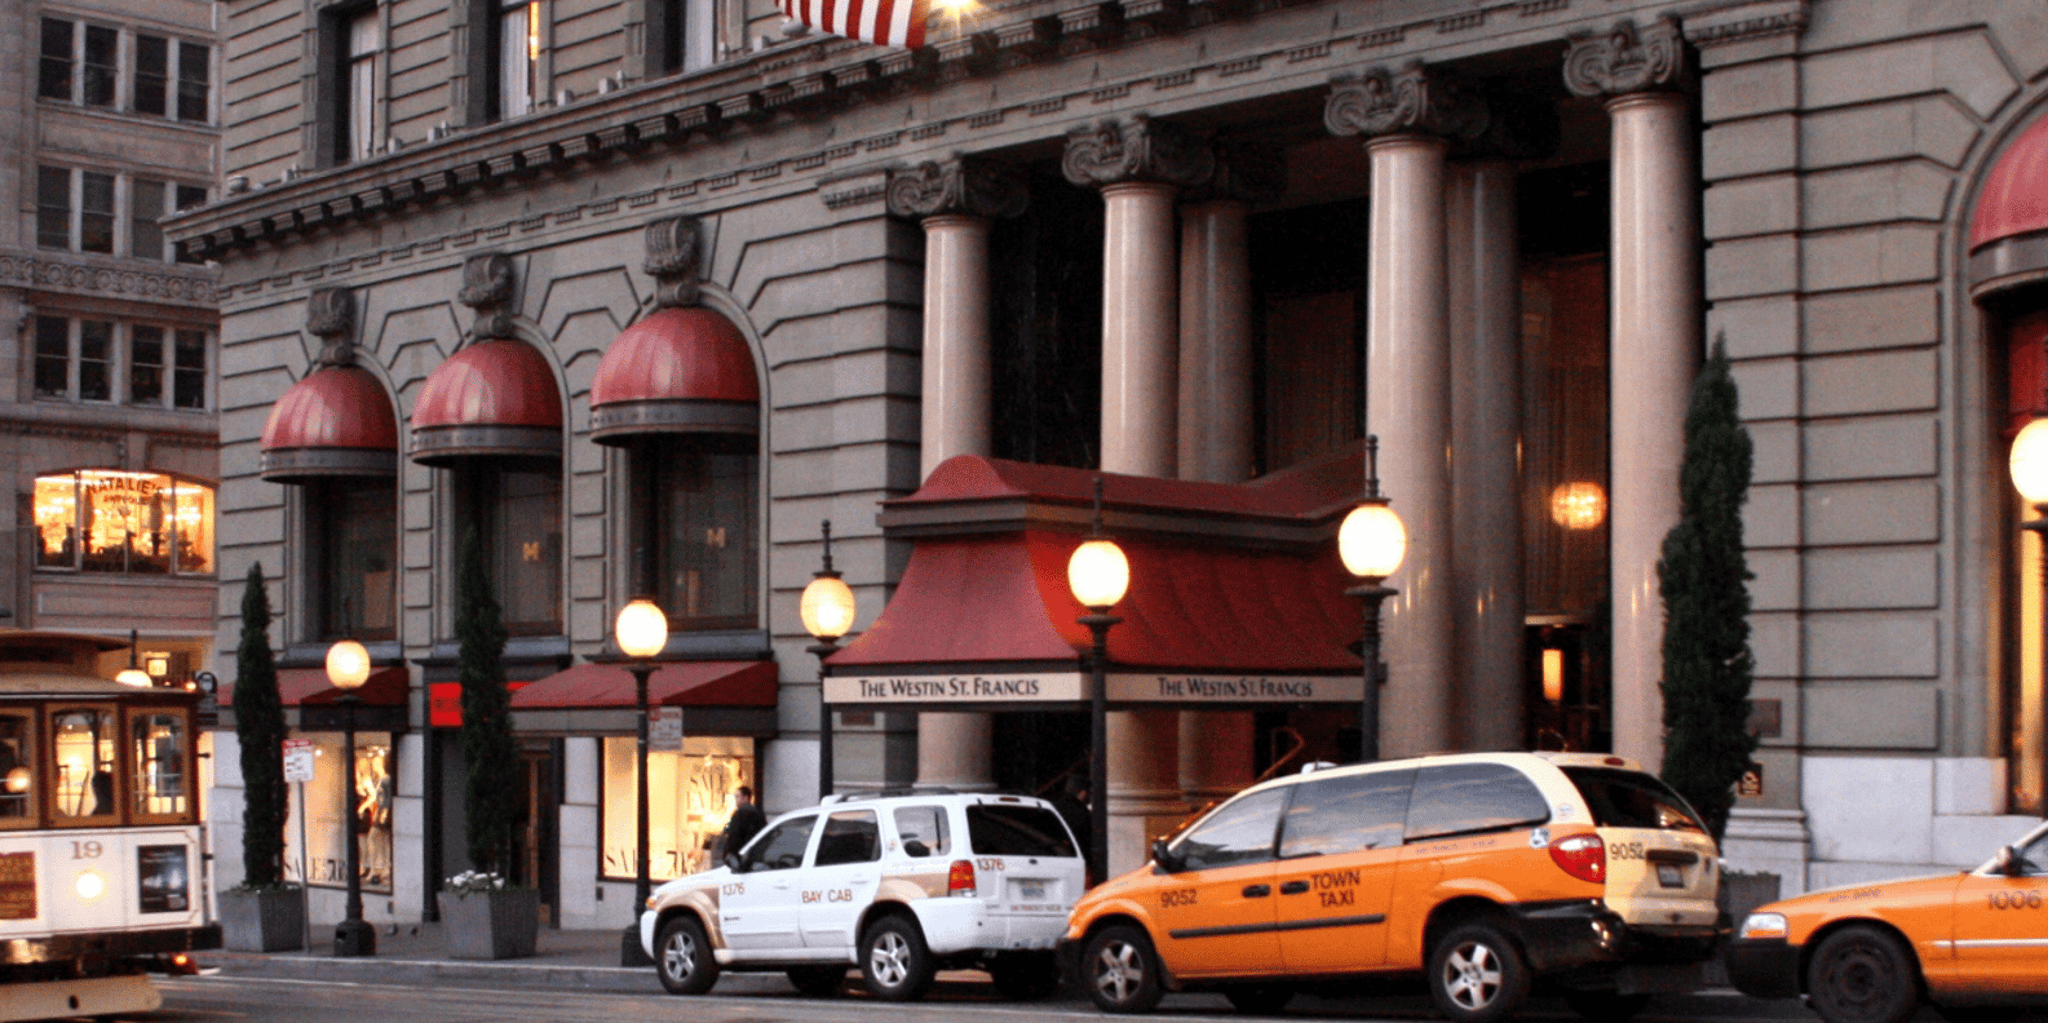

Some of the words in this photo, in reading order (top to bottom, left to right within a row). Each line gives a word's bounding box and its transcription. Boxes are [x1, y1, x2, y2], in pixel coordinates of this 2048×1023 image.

[859, 679, 886, 698] THE
[889, 679, 946, 696] WESTIN
[949, 677, 970, 696] ST.
[973, 677, 1040, 696] FRANCIS
[1157, 677, 1184, 697] THE
[1187, 677, 1238, 696] WESTIN
[1239, 678, 1259, 697] ST.
[1260, 678, 1313, 697] FRANCIS
[71, 840, 104, 860] 19
[1609, 843, 1645, 861] 9052
[976, 858, 1006, 872] 1376
[722, 881, 746, 896] 1376
[1311, 871, 1361, 890] TOWN
[801, 889, 823, 904] BAY
[827, 888, 853, 903] CAB
[1160, 888, 1198, 908] 9052
[1318, 889, 1355, 908] TAXI
[1987, 890, 2043, 911] 1006
